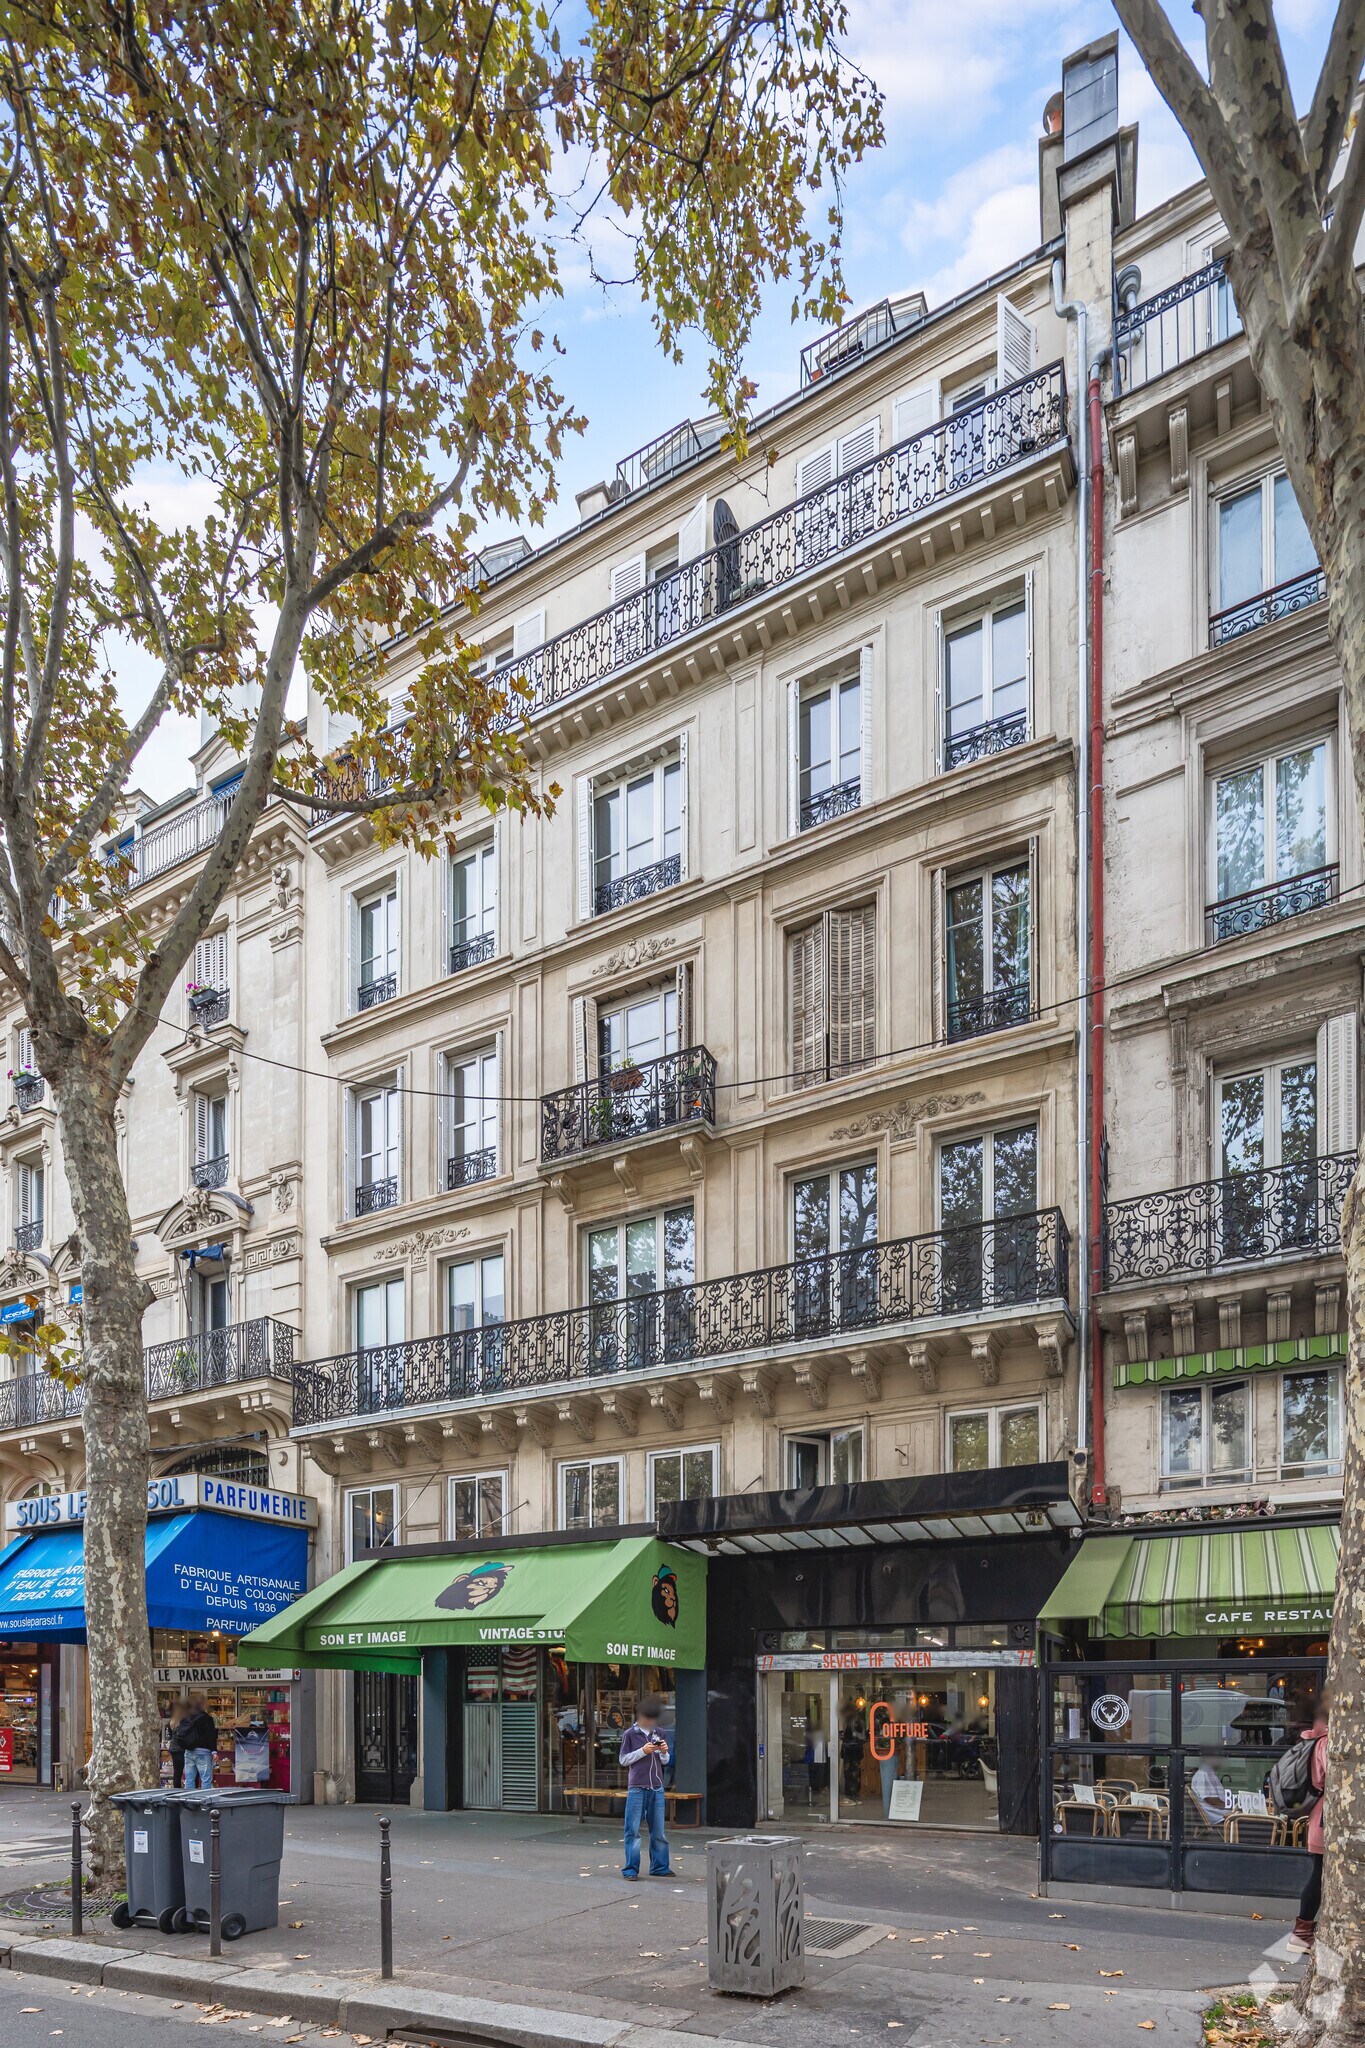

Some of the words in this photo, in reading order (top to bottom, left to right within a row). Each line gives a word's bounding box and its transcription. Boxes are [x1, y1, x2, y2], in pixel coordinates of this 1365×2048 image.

[16, 1496, 61, 1526] SOUS
[68, 1491, 87, 1520] LE
[204, 1480, 307, 1521] PARFUMERIE
[13, 1567, 64, 1579] FABRIQUE
[174, 1563, 232, 1582] FABRIQUE
[237, 1574, 301, 1591] ARTISANALE
[57, 1577, 85, 1587] COLO
[10, 1590, 50, 1602] DEPUIS
[224, 1584, 240, 1597] DE
[245, 1588, 295, 1602] COLOGNE
[206, 1595, 247, 1610] DEPUIS
[253, 1602, 277, 1613] 1936
[1205, 1611, 1253, 1623] CAFE
[1264, 1608, 1334, 1621] RESTAU
[206, 1617, 262, 1632] PARFUME
[320, 1634, 344, 1646] SON
[348, 1633, 363, 1644] ET
[367, 1630, 407, 1643] IMAGE
[479, 1627, 535, 1640] VINTAGE
[537, 1630, 566, 1639] STO
[606, 1642, 629, 1656] SON
[631, 1644, 645, 1657] ET
[647, 1646, 676, 1661] IMAGE
[823, 1653, 858, 1669] SEVEN
[867, 1652, 884, 1667] TIF
[894, 1651, 932, 1667] SEVEN
[1017, 1649, 1034, 1666] 77
[158, 1669, 171, 1682] LE
[178, 1667, 229, 1682] PARASOL
[1224, 1788, 1267, 1810] Brunch
